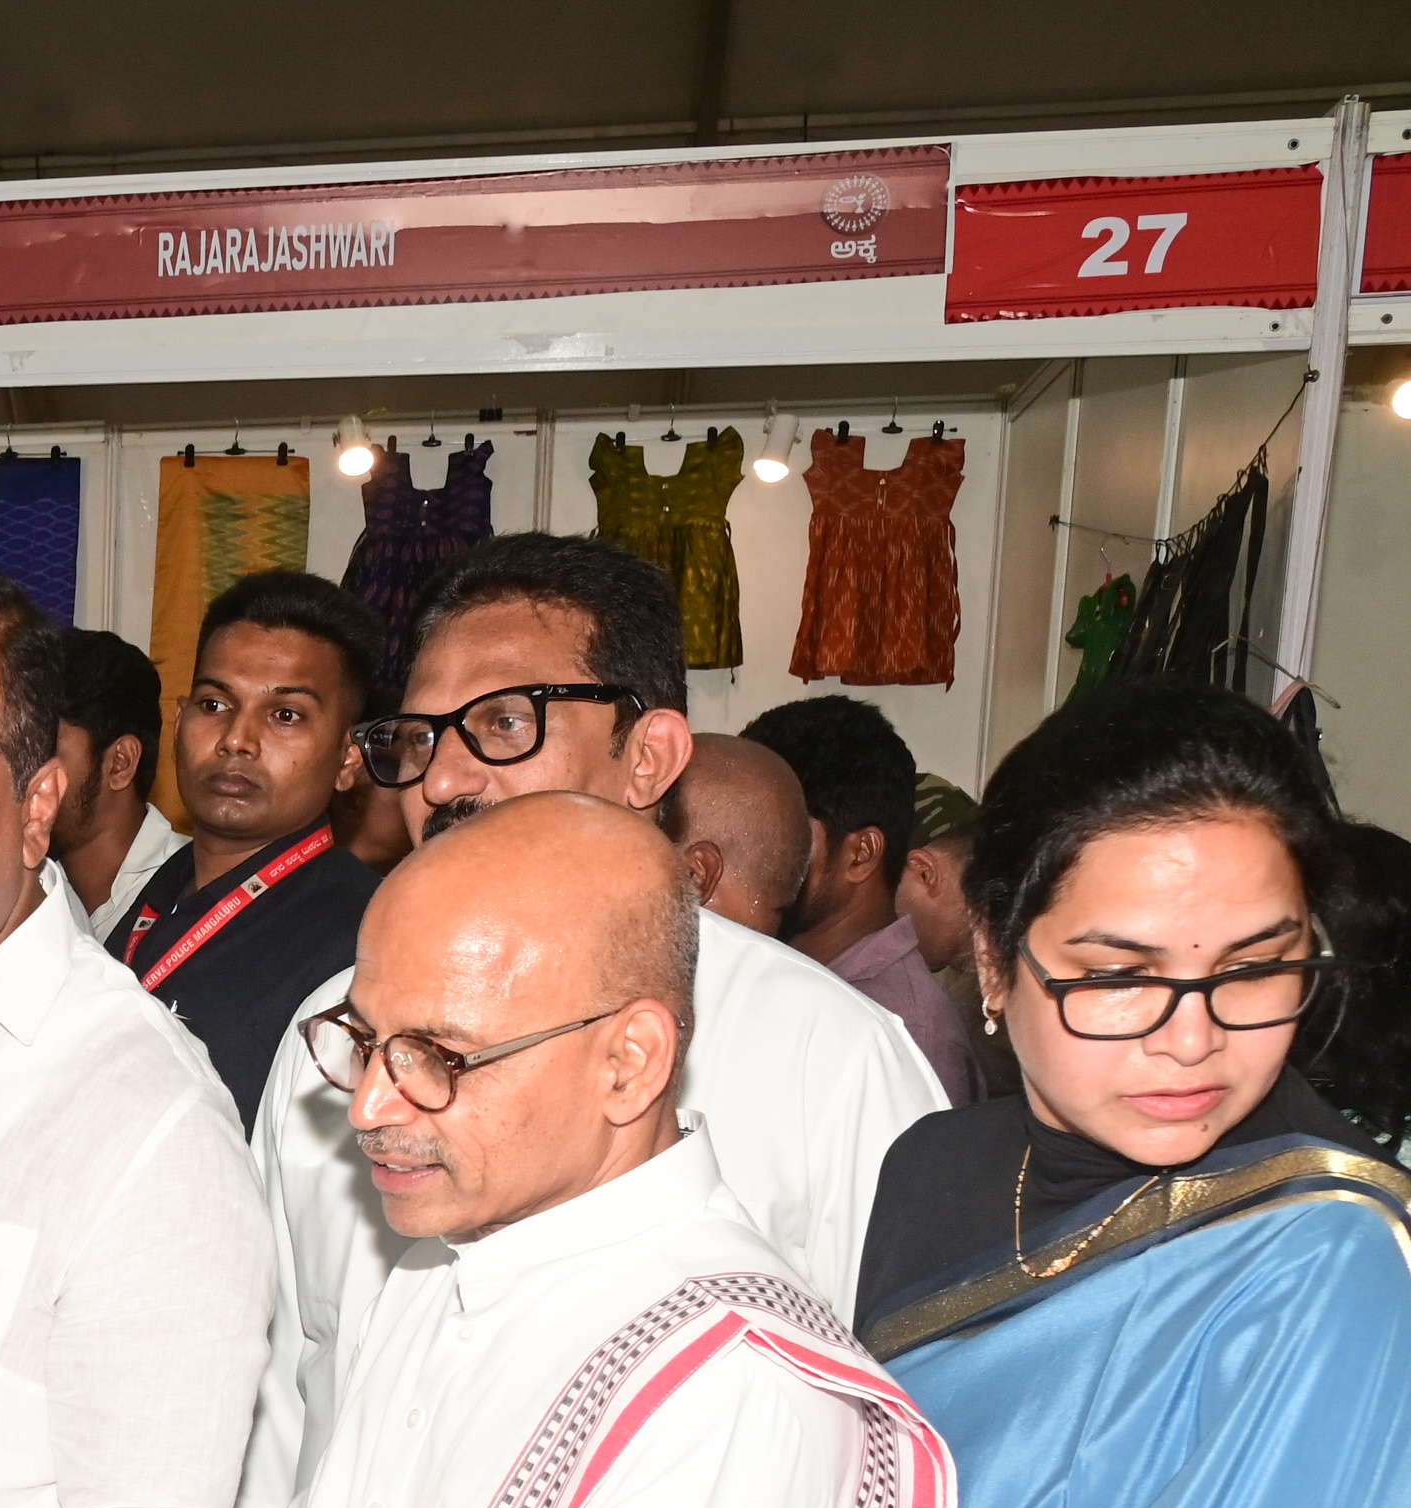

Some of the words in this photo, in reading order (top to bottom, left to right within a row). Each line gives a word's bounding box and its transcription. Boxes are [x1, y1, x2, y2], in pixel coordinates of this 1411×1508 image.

[157, 219, 397, 277] RAJARAJASHWARI
[831, 234, 878, 265] ಅಕ್ಕ
[1077, 212, 1189, 279] 27
[165, 938, 195, 968] POLICE
[192, 896, 242, 942] MANGALURU
